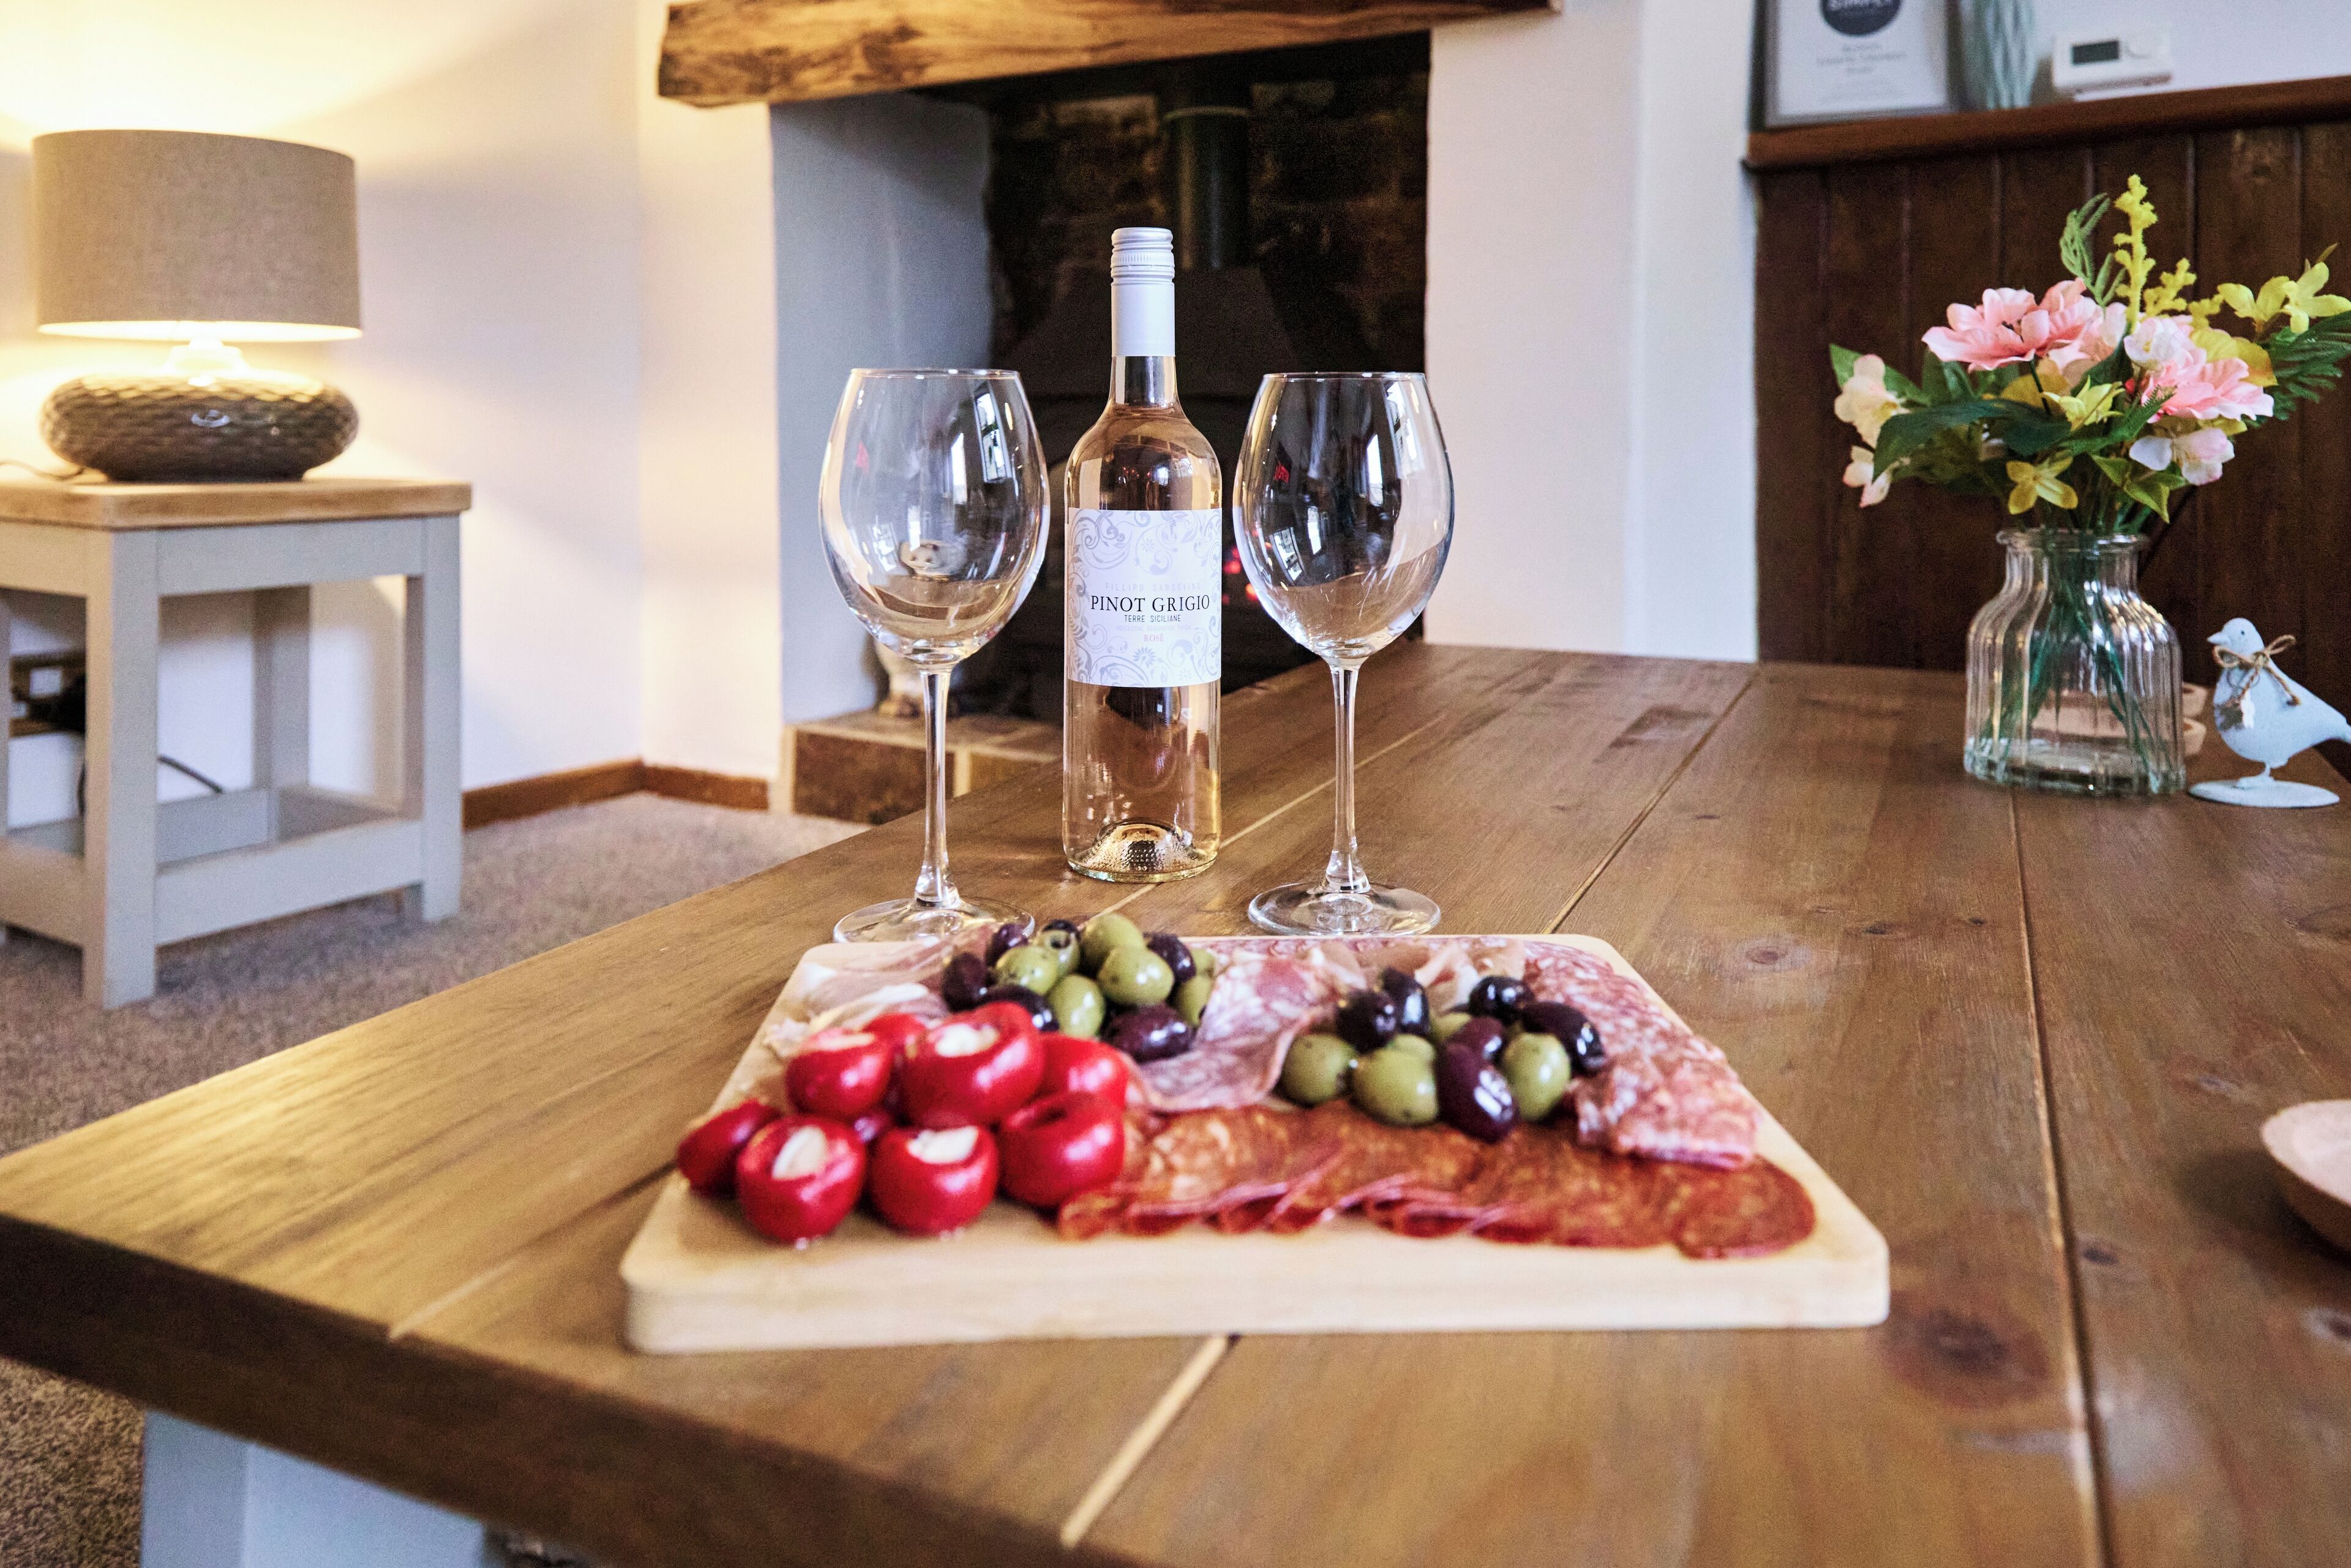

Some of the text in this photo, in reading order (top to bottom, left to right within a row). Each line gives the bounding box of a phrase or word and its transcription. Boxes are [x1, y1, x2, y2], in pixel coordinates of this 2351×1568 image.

[1090, 594, 1210, 612] PINOT GRIGIO
[1124, 614, 1182, 623] TERRE SICILIANE
